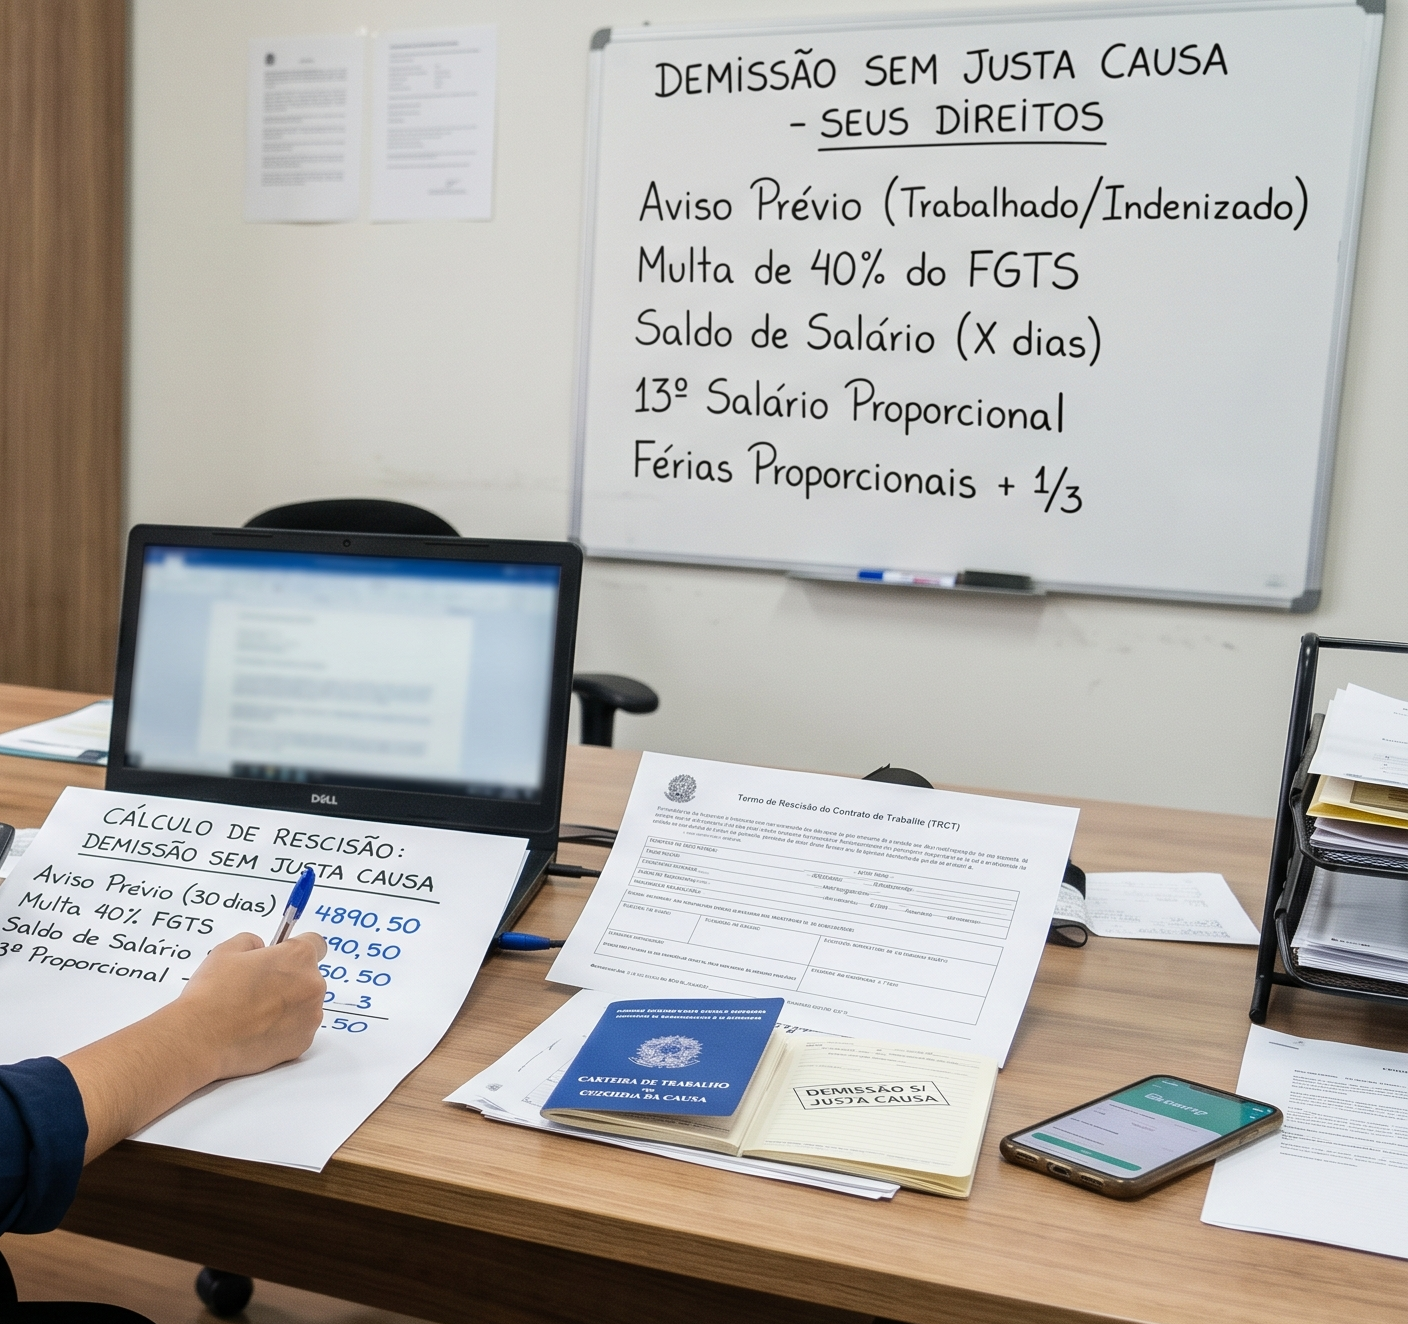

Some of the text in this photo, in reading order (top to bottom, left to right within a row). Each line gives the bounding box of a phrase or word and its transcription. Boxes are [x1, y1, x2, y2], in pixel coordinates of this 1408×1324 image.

[654, 42, 1229, 99] DEMISSÃO SEM JUSTA CAUSA
[820, 106, 909, 139] SEUS
[935, 97, 1104, 136] DIREITOS
[638, 174, 1309, 232] Aviso Prévio (Trabalhado/Indenizado)
[638, 245, 1080, 291] Multa de 40% do FGTS
[634, 308, 1101, 368] Saldo de Salário (X dias)
[634, 376, 1064, 437] 13º Salário Proporcional
[634, 439, 733, 484] Férias
[747, 440, 977, 501] Proporcionais
[1033, 465, 1083, 514] 1/3
[311, 793, 338, 805] DELL
[766, 798, 777, 806] de
[819, 805, 831, 814] do
[832, 806, 871, 819] Contrato
[872, 812, 884, 821] de
[927, 819, 961, 833] (TRCT)
[103, 803, 405, 860] CÁLCULO DE RESCISÃO:
[81, 832, 434, 893] DEMISSÃO SEM JUSTA CAUSA
[17, 891, 214, 935] Multa 40% FGTS
[32, 864, 277, 918] Aviso Prévio (30 dias)
[1, 916, 192, 960] Saldo de Salário
[322, 934, 402, 960] 90,50
[27, 945, 170, 983] Proporcional
[639, 1078, 659, 1086] DE
[874, 1095, 939, 1104] CAUSA
